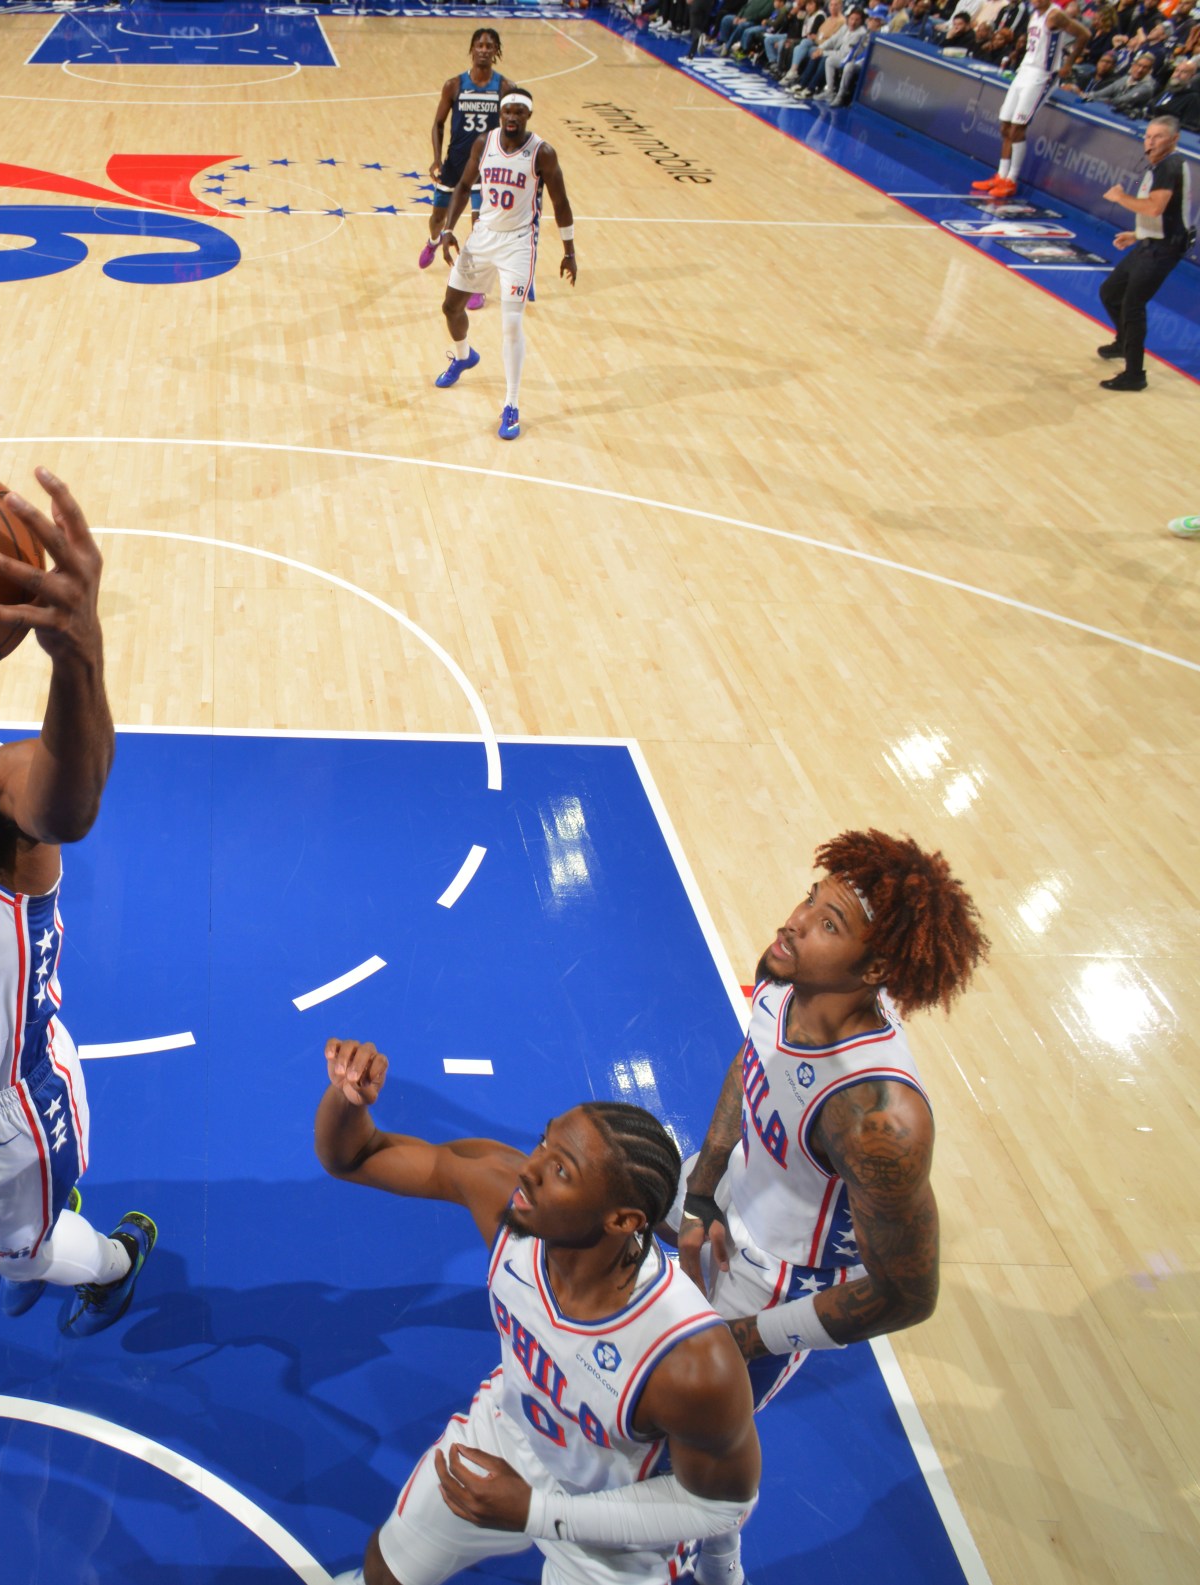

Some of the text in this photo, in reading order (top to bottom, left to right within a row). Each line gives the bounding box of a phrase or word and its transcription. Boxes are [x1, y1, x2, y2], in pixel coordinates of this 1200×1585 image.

[332, 8, 585, 19] crypto.com
[458, 101, 498, 113] MINNESOTA
[463, 113, 488, 133] 33
[559, 118, 622, 157] ARENA
[483, 167, 527, 190] PHILA
[628, 137, 717, 184] mobile
[1034, 135, 1066, 165] ONE
[1064, 147, 1139, 194] INTERNET
[489, 188, 515, 211] 30
[511, 285, 524, 297] 76
[784, 1069, 805, 1107] crypto.com
[492, 1291, 613, 1449] PHILA
[575, 1353, 619, 1398] crypto.com
[520, 1392, 568, 1448] 0
